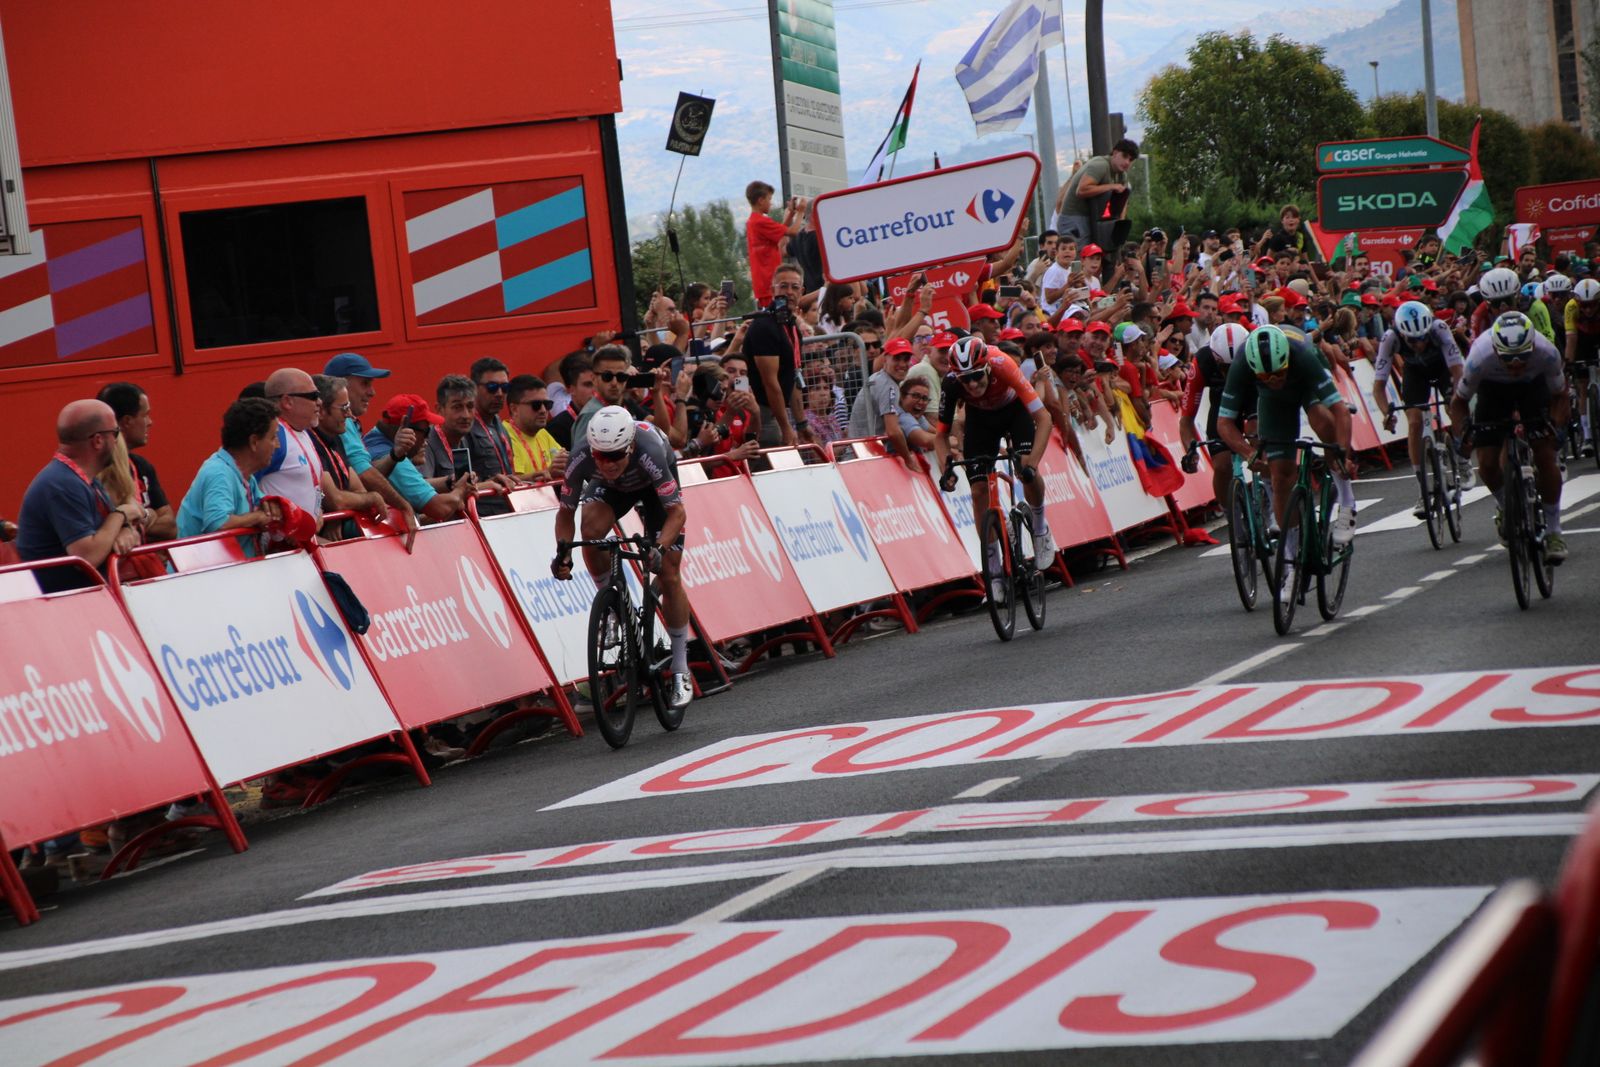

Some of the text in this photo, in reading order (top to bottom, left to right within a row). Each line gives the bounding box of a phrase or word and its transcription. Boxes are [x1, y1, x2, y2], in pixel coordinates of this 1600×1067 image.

[1333, 148, 1376, 162] caser
[1375, 152, 1398, 161] Grupo
[1338, 191, 1438, 212] SKODA
[836, 208, 955, 248] Carrefour
[1361, 235, 1396, 245] Carrefour
[1370, 261, 1393, 278] 50
[775, 507, 844, 562] Carrefour
[858, 493, 926, 545] Carrefour
[160, 624, 302, 712] Carrefour
[0, 664, 109, 757] rrefour
[639, 668, 1600, 793] COFIDIS
